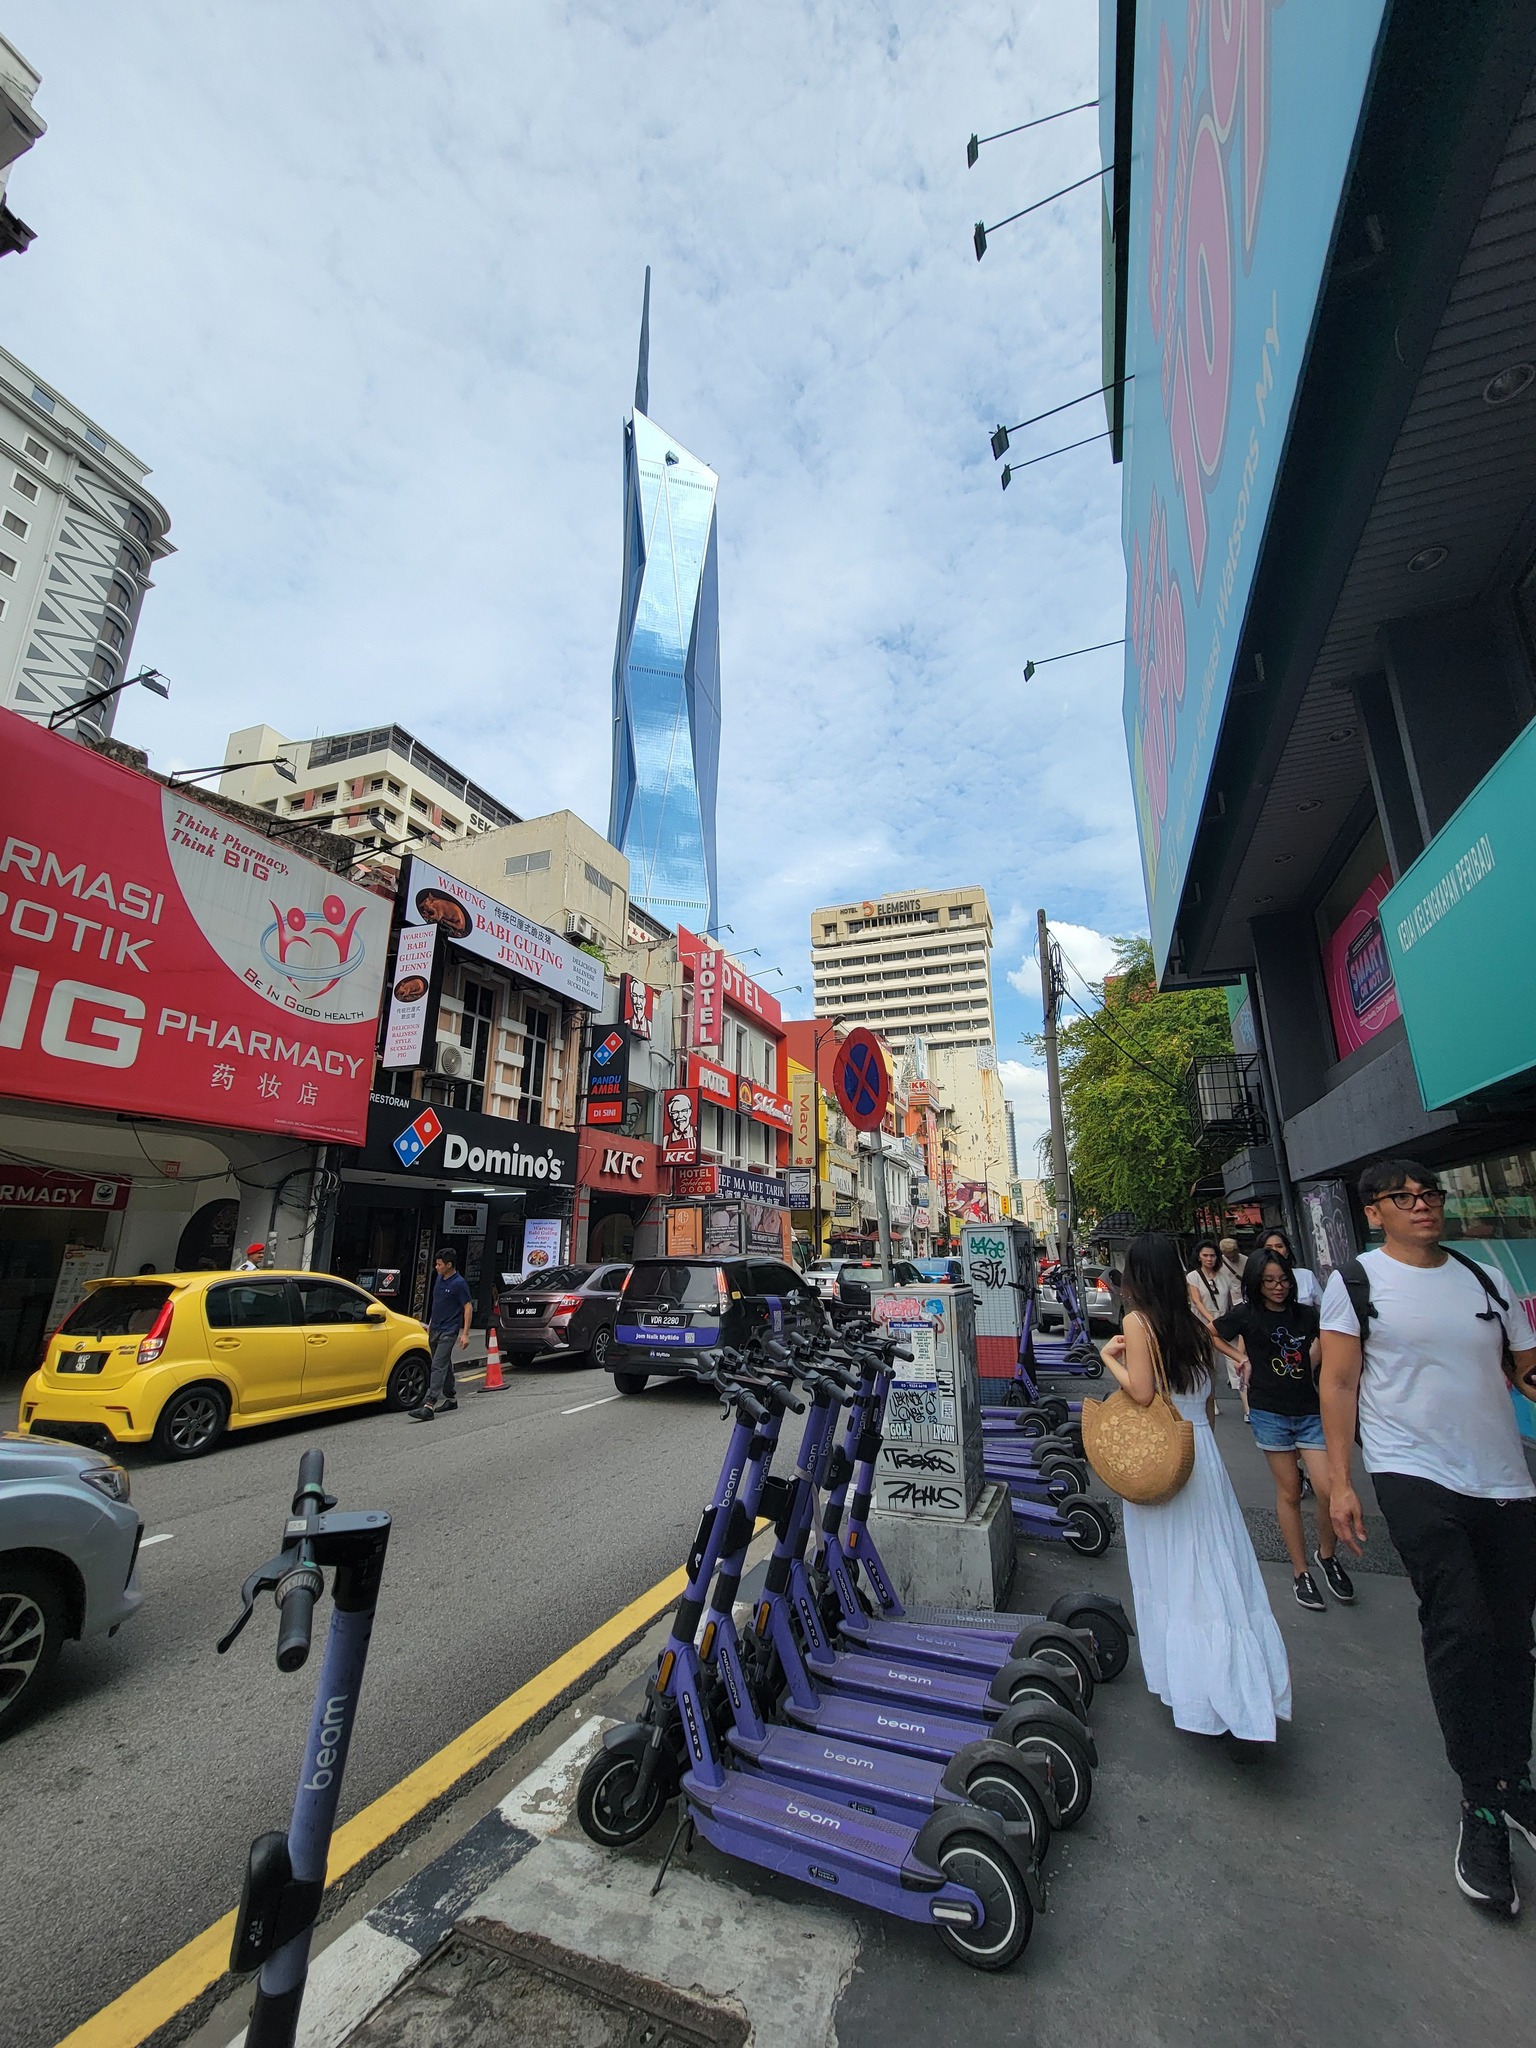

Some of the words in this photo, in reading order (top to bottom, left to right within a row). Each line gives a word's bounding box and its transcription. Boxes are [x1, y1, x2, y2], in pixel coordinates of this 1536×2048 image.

[1151, 54, 1169, 307] RABU
[1195, 617, 1221, 739] Aplikasi
[1215, 426, 1261, 630] Watsons
[1255, 289, 1280, 429] MY
[175, 810, 220, 841] Think
[221, 832, 290, 876] Pharmacy,
[171, 828, 216, 858] Think
[223, 848, 270, 882] BIG
[437, 875, 487, 911] WARUNG
[1396, 912, 1418, 954] KEDAI
[1411, 869, 1462, 939] KELENGKAPAN
[1454, 832, 1496, 896] PERIBADI
[840, 907, 859, 915] HOTEL
[877, 898, 921, 915] ELEMENTS
[402, 930, 434, 941] WARUNG
[406, 941, 427, 951] BABI
[475, 913, 511, 945] BABI
[513, 933, 564, 970] GULING
[399, 950, 432, 962] GULING
[497, 944, 544, 977] JENNY
[571, 956, 598, 975] DELICIOUS
[399, 961, 429, 973] JENNY
[566, 979, 590, 995] SUCKLING
[575, 975, 591, 988] STYLE
[700, 951, 716, 1043] HOTEL
[324, 1010, 365, 1021] HEALTH
[157, 1007, 365, 1079] PHARMACY
[211, 1063, 319, 1107] 药妆店
[590, 1083, 621, 1096] AMBIL
[591, 1074, 622, 1086] PANDU
[698, 1065, 731, 1098] HOTEL
[911, 1081, 927, 1089] KK
[369, 1092, 410, 1109] RESTORAN
[593, 1109, 602, 1117] DI
[602, 1108, 617, 1117] SINI
[798, 1094, 810, 1147] Macy
[443, 1133, 562, 1181] Domino's
[603, 1148, 645, 1179] KFC
[664, 1151, 695, 1163] KFC
[680, 1168, 712, 1178] HOTEL
[733, 1178, 747, 1190] MA
[747, 1180, 764, 1193] MEE
[765, 1183, 785, 1198] TARIK
[659, 1333, 680, 1341] MyRide
[820, 1425, 835, 1456] beam
[890, 1423, 911, 1437] GOLF
[807, 1443, 819, 1474] eam
[754, 1455, 772, 1491] beam
[718, 1468, 740, 1508] beam
[957, 1614, 996, 1624] beam
[916, 1633, 957, 1648] beam
[888, 1669, 932, 1686] beam
[683, 1693, 702, 1759] BK554
[877, 1715, 926, 1734] beam
[304, 1692, 349, 1792] beam
[823, 1747, 874, 1770] beam
[786, 1801, 841, 1830] beam
